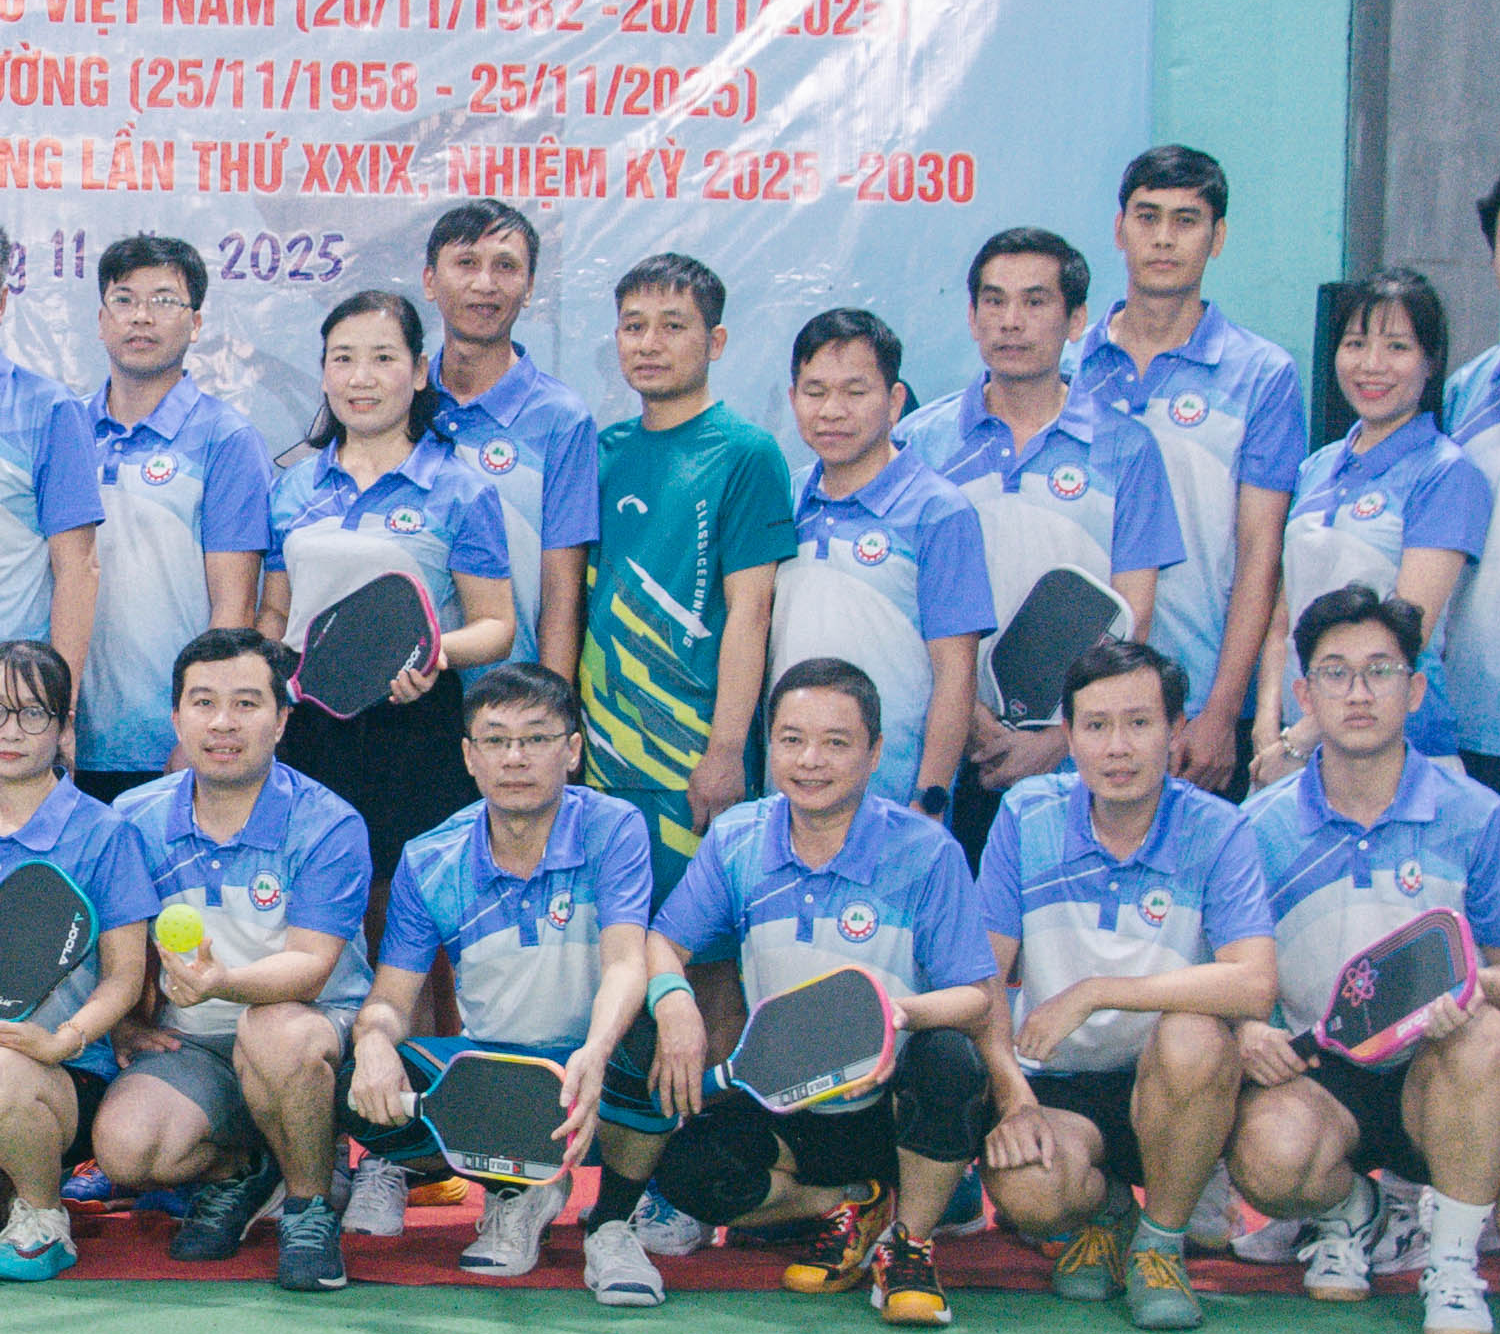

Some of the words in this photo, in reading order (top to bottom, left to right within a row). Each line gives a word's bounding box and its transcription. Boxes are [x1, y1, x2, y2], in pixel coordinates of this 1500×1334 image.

[129, 57, 419, 114] (25/11/1958
[81, 121, 175, 191] LẦN
[192, 131, 290, 194] THỨ
[302, 143, 429, 200] XXIX,
[447, 136, 607, 210] NHIỆM
[626, 137, 688, 199] KỲ
[703, 149, 821, 202] 2025
[51, 228, 87, 280] 11
[218, 231, 346, 283] 2025
[58, 921, 80, 966] JOOLA
